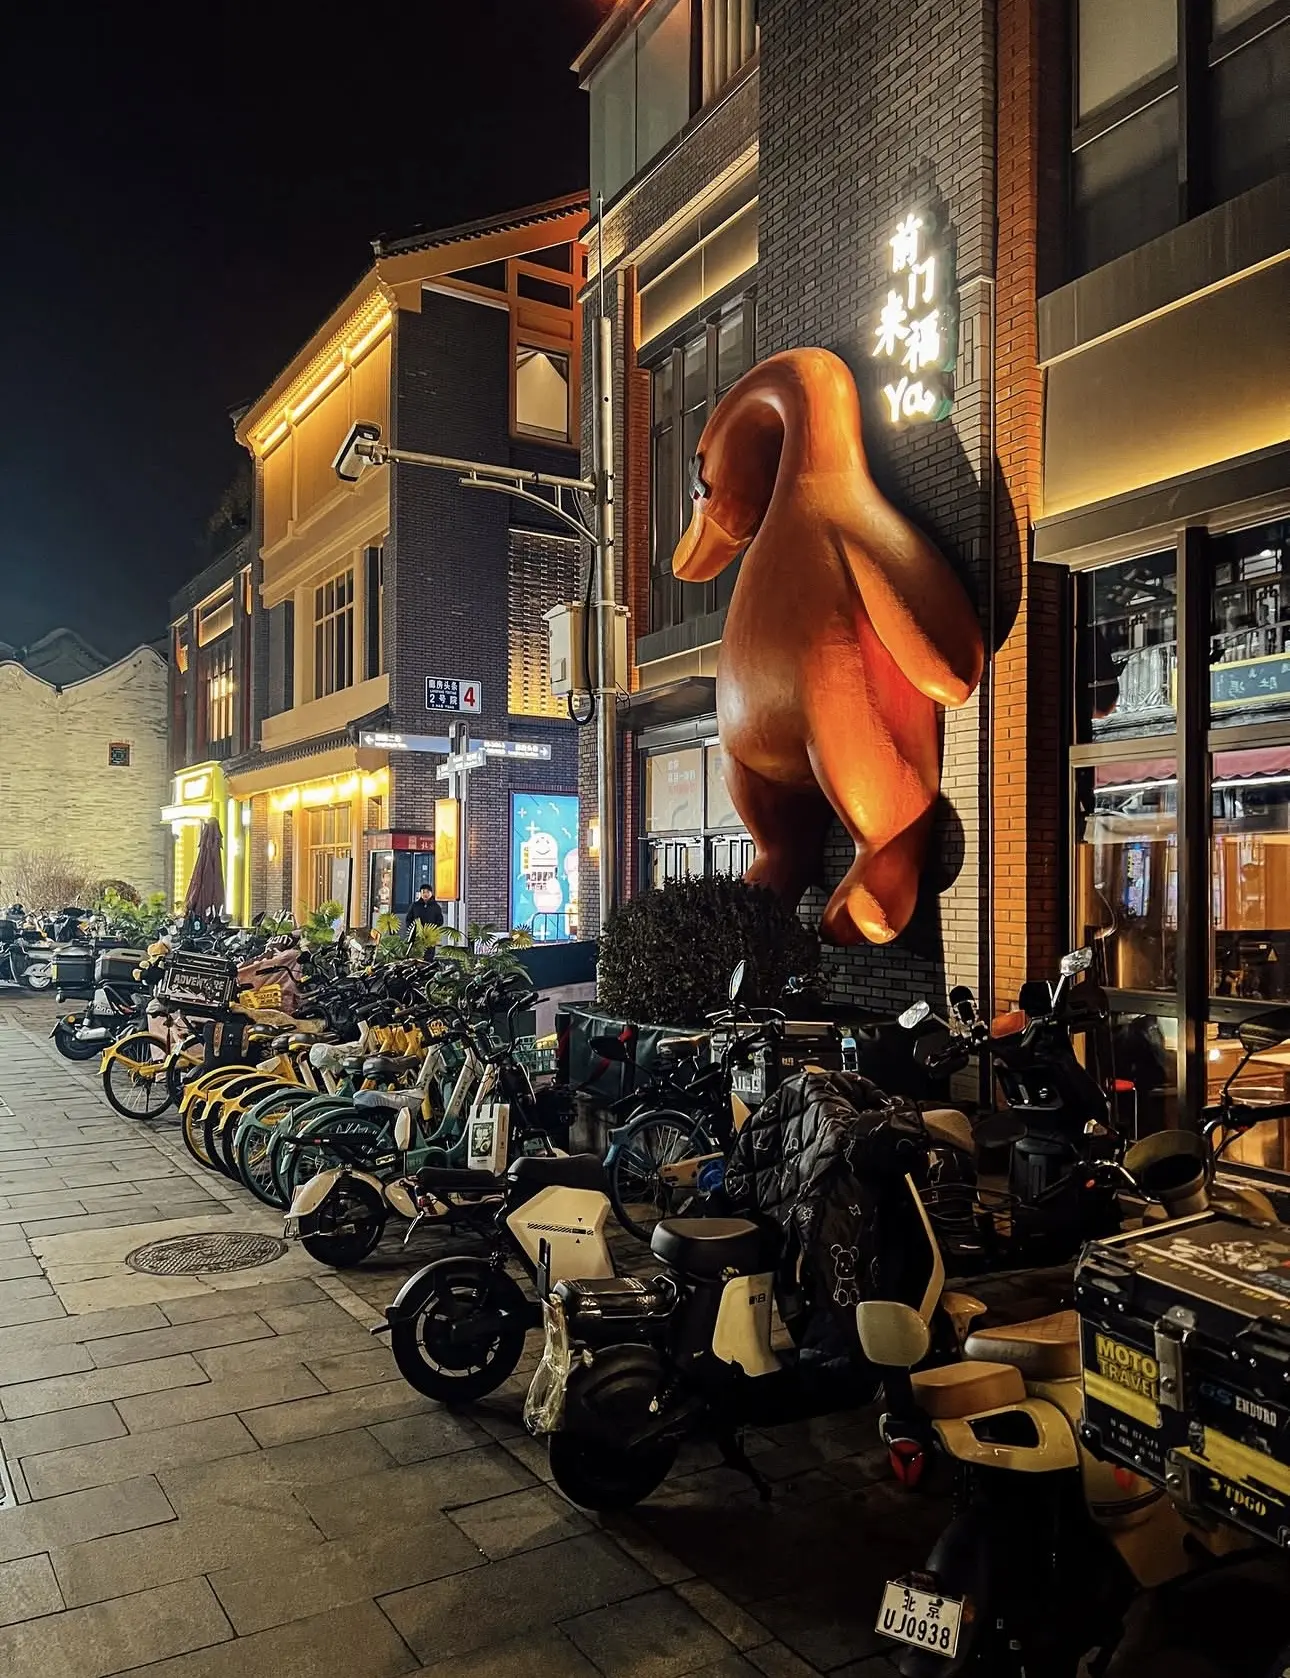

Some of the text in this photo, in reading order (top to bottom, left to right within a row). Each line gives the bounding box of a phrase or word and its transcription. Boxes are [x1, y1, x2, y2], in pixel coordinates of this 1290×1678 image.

[463, 686, 476, 707] 4
[1096, 1335, 1158, 1379] MOTO
[1099, 1358, 1159, 1400] TRAVEL
[1235, 1395, 1277, 1427] ENDURO
[901, 1589, 943, 1620] 北京
[883, 1608, 951, 1650] UJ0938
